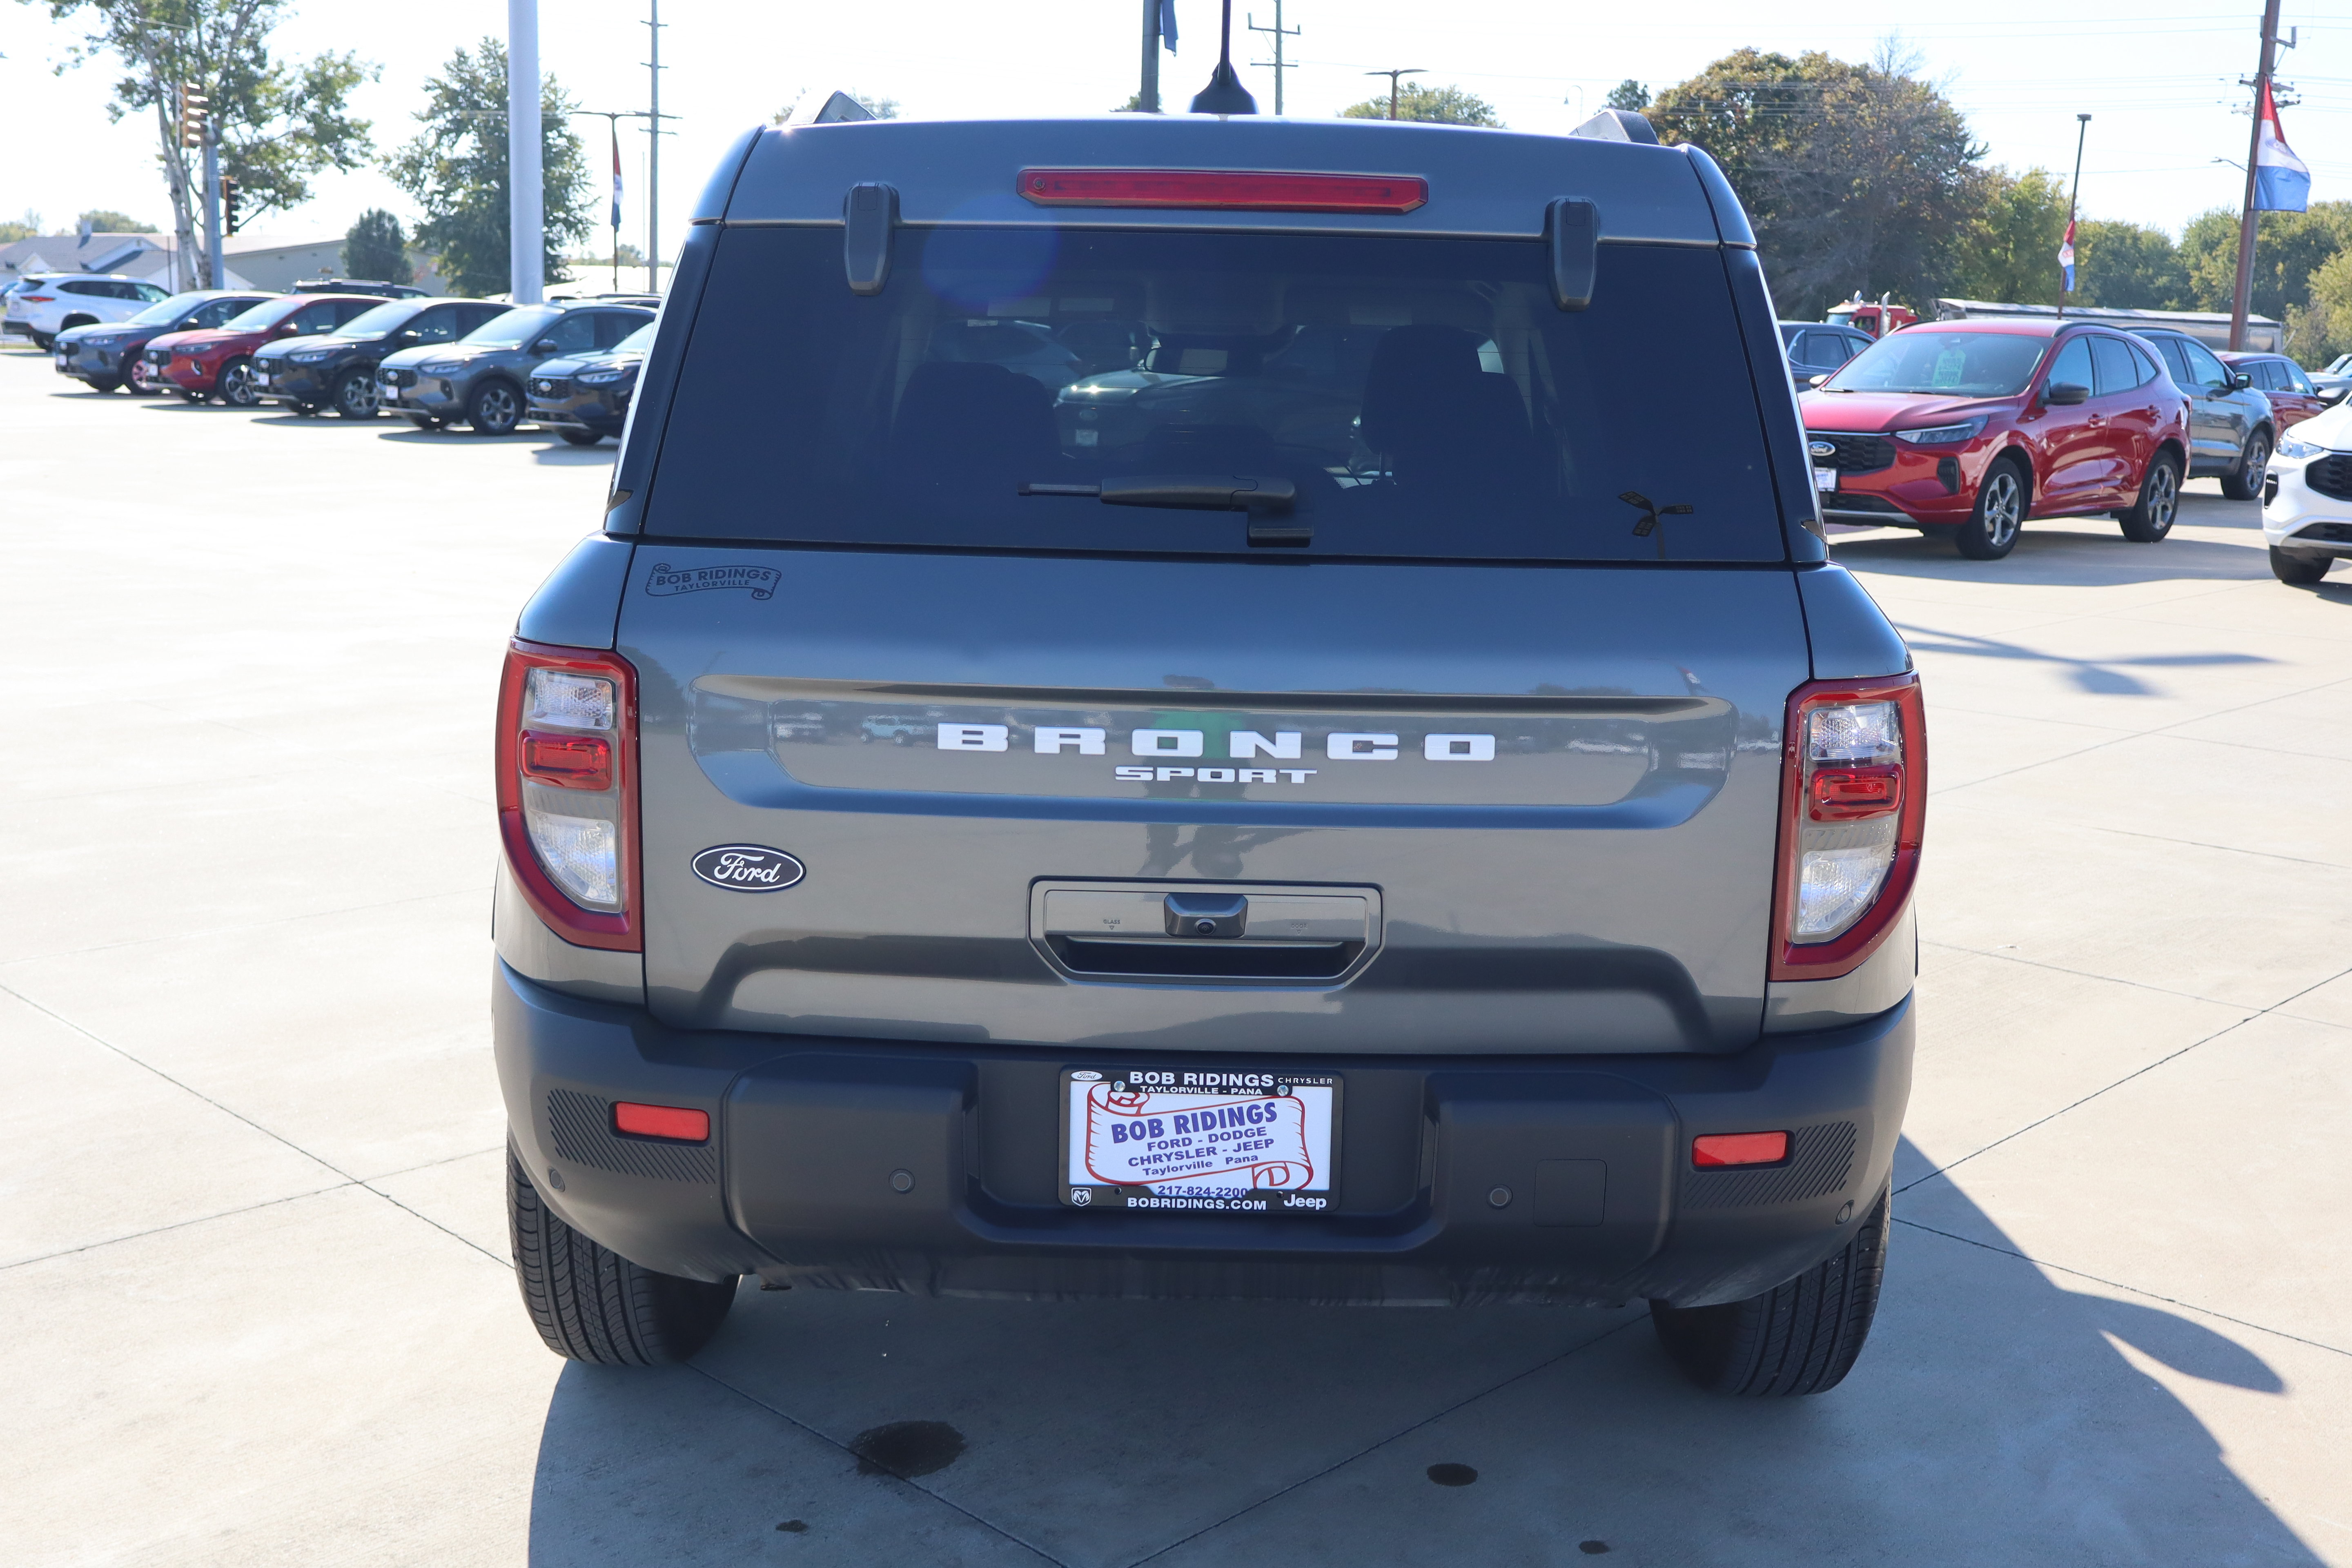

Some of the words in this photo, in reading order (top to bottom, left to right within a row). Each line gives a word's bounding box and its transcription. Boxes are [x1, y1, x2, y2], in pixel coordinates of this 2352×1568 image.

[656, 573, 692, 586] BOB
[698, 568, 771, 581] RIDINGS
[674, 580, 750, 592] TAYLORVILLE
[938, 723, 1495, 761] BRONCO
[1115, 765, 1317, 784] SPORT
[714, 853, 782, 882] Ford
[1130, 1071, 1175, 1085] BOB
[1184, 1073, 1274, 1087] RIDINGS
[1140, 1085, 1219, 1094] TAYLORVILLE
[1111, 1118, 1165, 1144] BOB
[1174, 1102, 1277, 1135] RIDINGS
[1147, 1137, 1193, 1152] FORD
[1208, 1126, 1267, 1143] DODGE
[1128, 1146, 1218, 1167] CHRYSLER
[1232, 1138, 1274, 1153] JEEP
[1143, 1160, 1213, 1176] Taylorville
[1225, 1155, 1258, 1165] Pana
[1157, 1185, 1248, 1197] 217-824-2200
[1127, 1197, 1267, 1210] BOBRIDINGS.COM
[1283, 1194, 1327, 1210] Jeep
